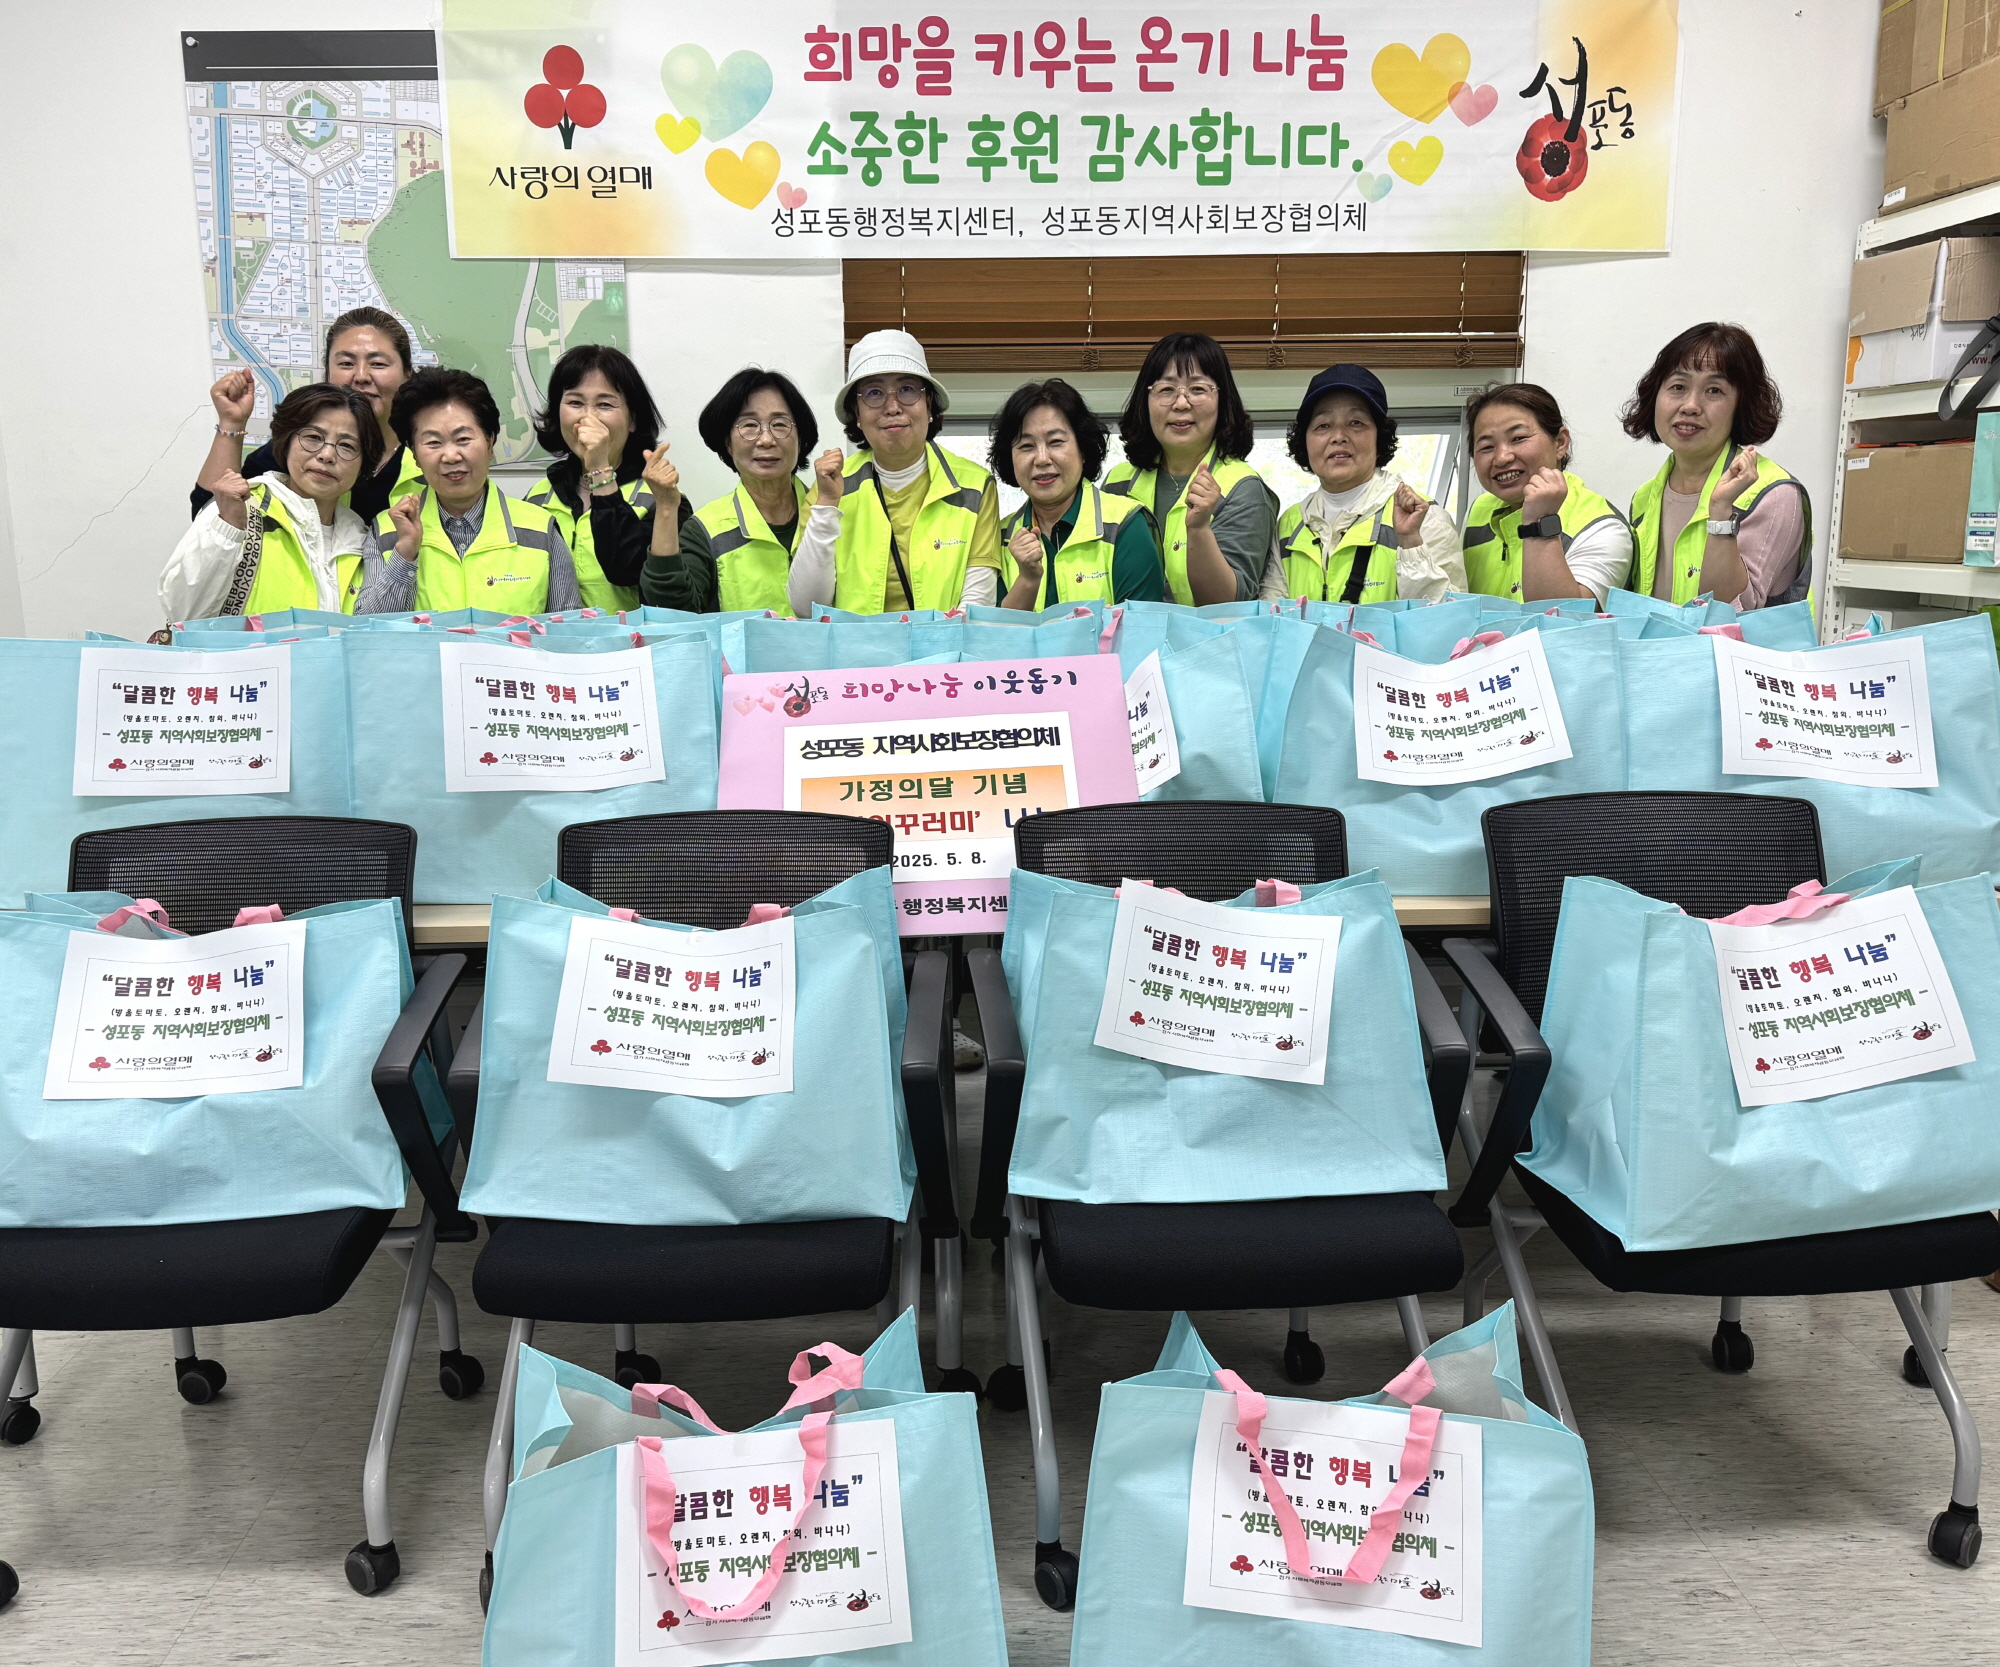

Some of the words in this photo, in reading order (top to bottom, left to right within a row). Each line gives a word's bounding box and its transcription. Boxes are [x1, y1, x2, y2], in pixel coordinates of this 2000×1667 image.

[803, 15, 955, 97] 희망을
[974, 16, 1117, 93] 키우는
[1134, 15, 1231, 94] 온기
[1251, 13, 1349, 92] 나눔
[805, 110, 949, 187] 소중한
[965, 110, 1061, 185] 후원
[1080, 106, 1366, 187] 감사합니다.
[770, 206, 1026, 239] 성포동행정복지센터,
[1041, 201, 1369, 237] 성포동지역사회보장협의체
[112, 683, 176, 705] “달콤한
[187, 686, 218, 705] 행복
[230, 681, 267, 703] 나눔”
[475, 677, 535, 700] “달콤한
[546, 684, 576, 703] 행복
[589, 681, 629, 702] 나눔”
[841, 672, 964, 702] 희망나눔
[973, 667, 1078, 695] 이웃돕기
[1377, 682, 1426, 708] “달콤한
[1436, 688, 1469, 708] 행복
[1479, 666, 1519, 694] 나눔”
[1745, 670, 1796, 697] “달콤한
[1804, 683, 1837, 701] 행복
[1849, 675, 1896, 699] 나눔”
[117, 728, 153, 744] 성포동
[159, 727, 261, 744] 지역사회보장협의체
[485, 722, 520, 737] 성포동
[526, 723, 628, 741] 지역사회보장협의체
[1386, 724, 1415, 741] 성포동
[1420, 708, 1526, 741] 지역사회보장협의체
[1758, 710, 1789, 728] 성포동
[1793, 717, 1895, 738] 지역사회보장협의체
[799, 737, 865, 760] 성포동
[872, 726, 1061, 755] 지역사회보장협의체
[839, 776, 955, 803] 가정의달
[974, 771, 1028, 797] 기념
[892, 854, 938, 868] 2025.
[946, 852, 962, 866] 5.
[971, 851, 987, 864] 8.
[895, 895, 1009, 916] 행정복지센
[1144, 925, 1201, 961] “달콤한
[1212, 944, 1247, 970] 행복
[1260, 952, 1307, 973] 나눔”
[1731, 965, 1781, 991] “달콤한
[1789, 953, 1834, 983] 행복
[1844, 933, 1896, 966] 나눔”
[102, 974, 174, 997] “달콤한
[187, 972, 222, 996] 행복
[233, 960, 274, 988] 나눔”
[604, 954, 672, 987] “달콤한
[684, 970, 720, 991] 행복
[733, 961, 771, 988] 나눔”
[1141, 978, 1173, 1002] 성포동
[1179, 988, 1294, 1018] 지역사회보장협의체
[1748, 1019, 1779, 1040] 성포동
[1783, 988, 1916, 1034] 지역사회보장협의체
[102, 1024, 145, 1041] 성포동
[152, 1014, 270, 1039] 지역사회보장협의체
[604, 1005, 645, 1026] 성포동
[652, 1014, 765, 1036] 지역사회보장협의체
[1329, 1456, 1371, 1488] 행복
[749, 1483, 792, 1516] 행복
[1316, 1498, 1352, 1513] 오렌지,
[1400, 1510, 1430, 1524] 나나)
[739, 1531, 776, 1545] 오렌지,
[814, 1523, 851, 1538] 바나나)
[719, 1546, 860, 1579] 지역사보장협의체
